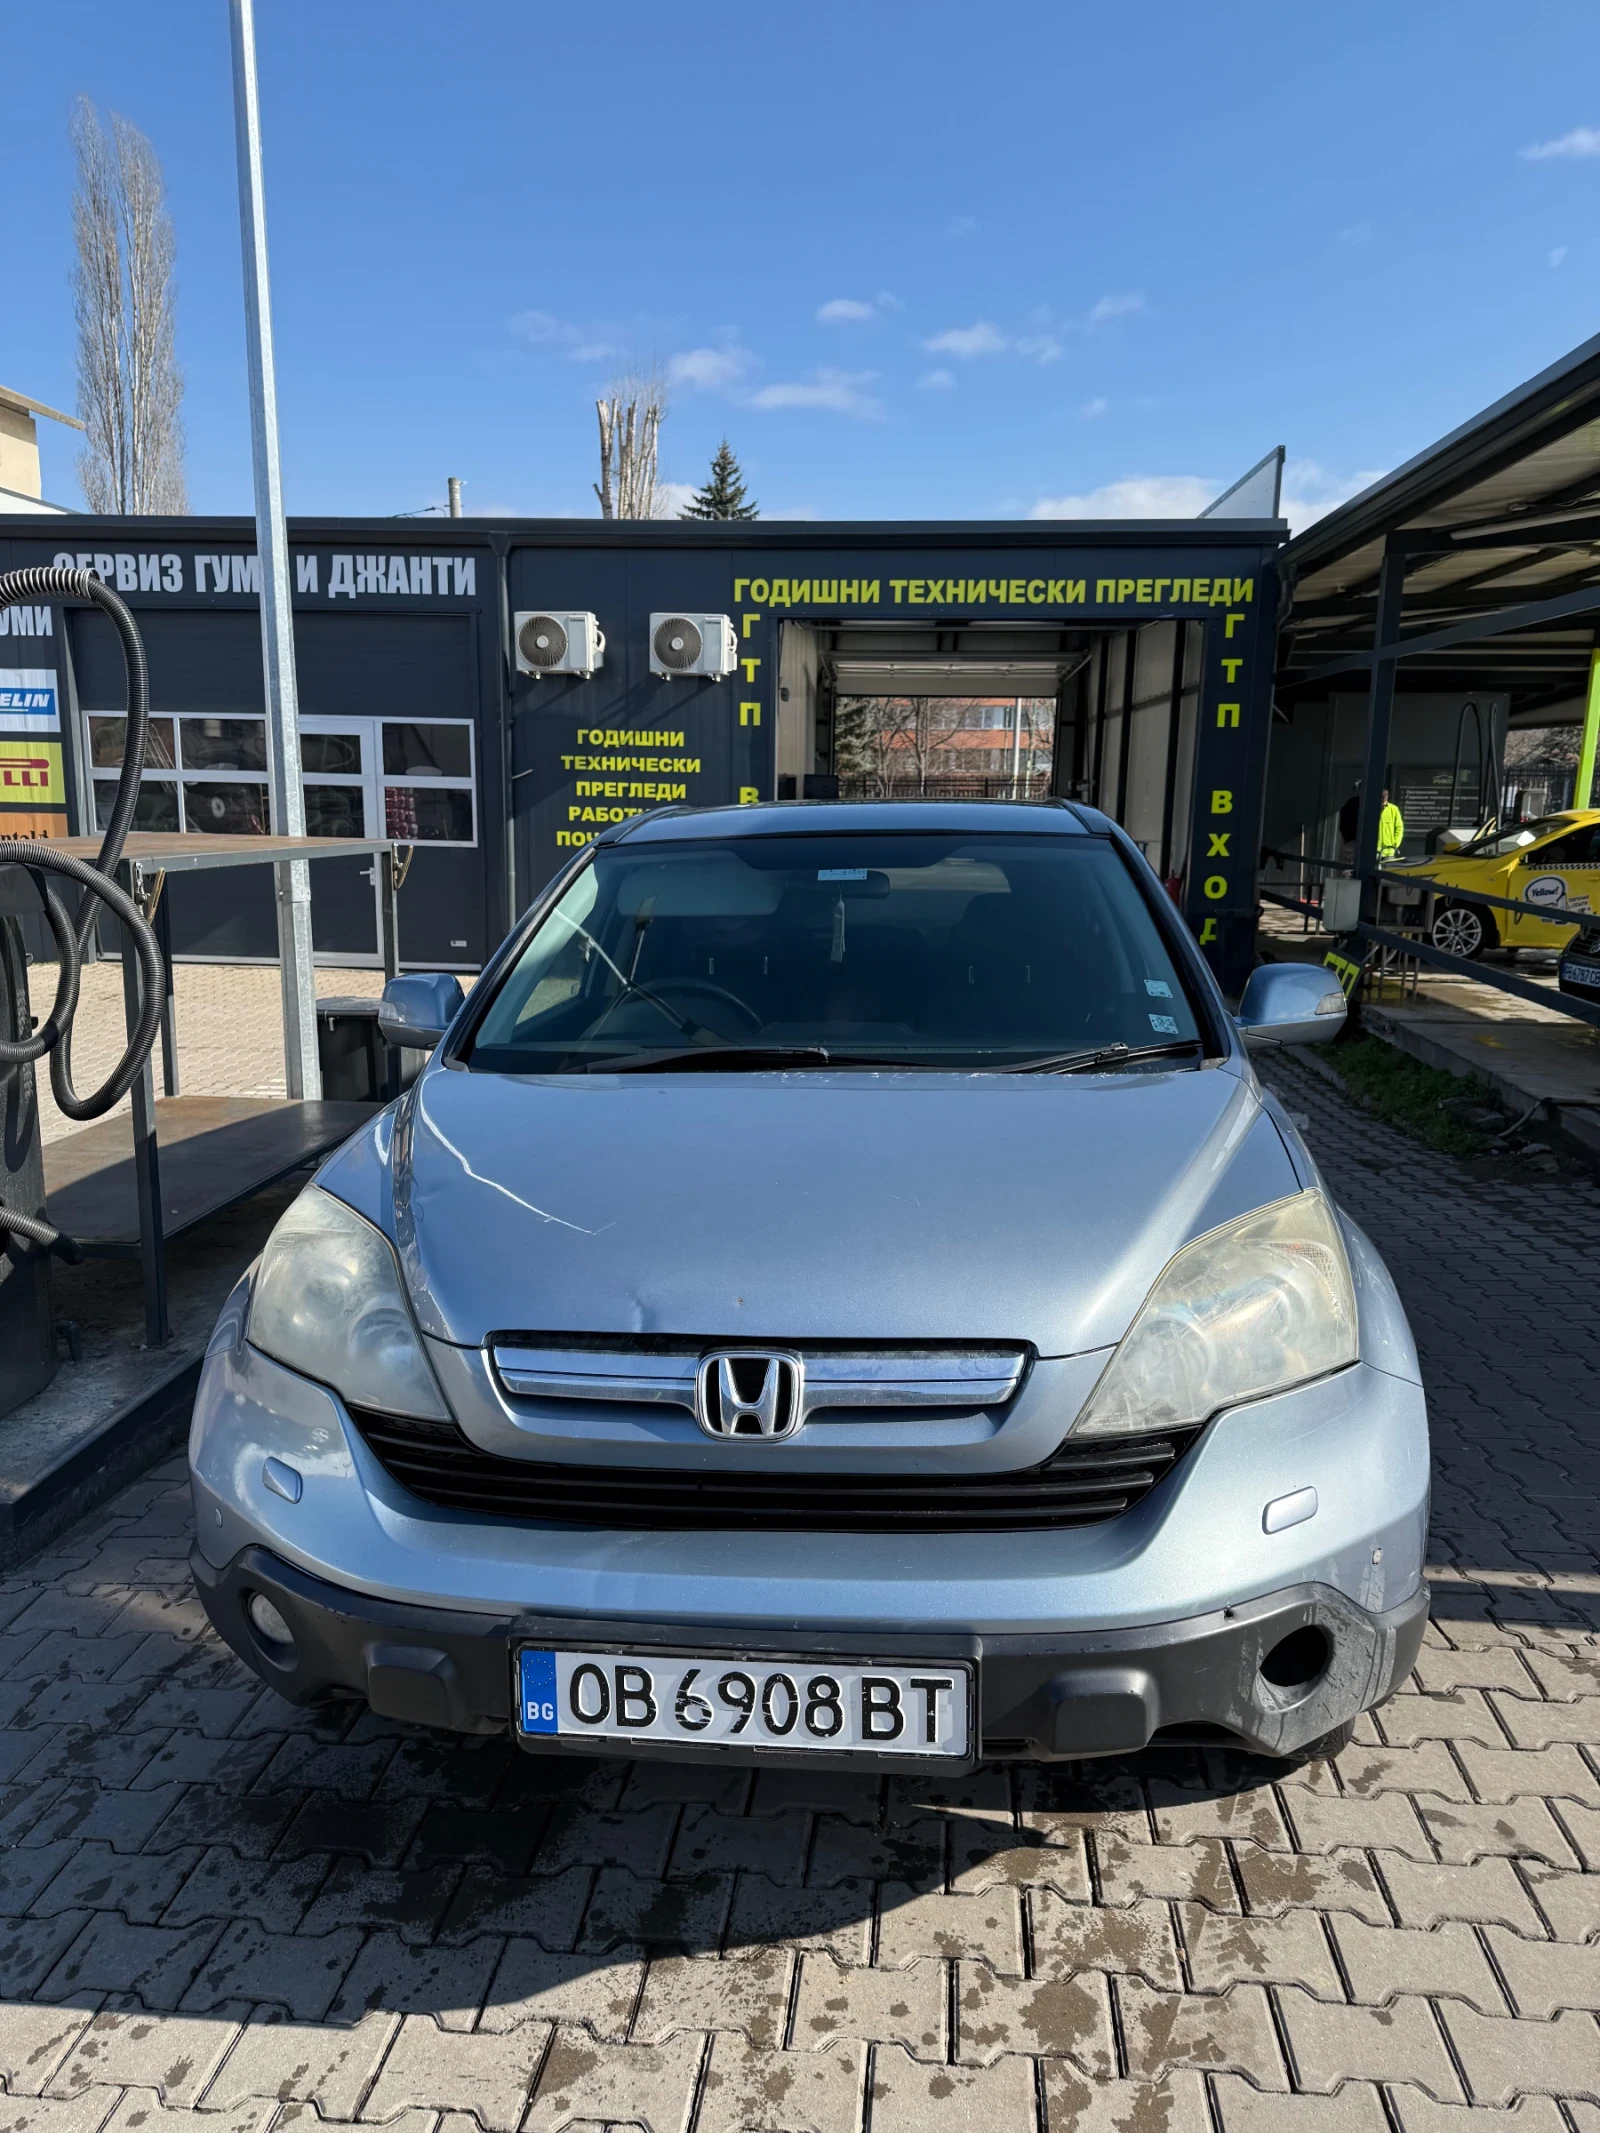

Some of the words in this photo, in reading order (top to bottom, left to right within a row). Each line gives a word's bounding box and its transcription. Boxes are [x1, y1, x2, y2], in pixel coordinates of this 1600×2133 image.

[194, 555, 262, 593] ГУМ
[296, 555, 319, 593] И
[328, 555, 477, 599] ДЖАНТИ
[734, 578, 880, 608] ГОДИШНИ
[889, 579, 1086, 604] ТЕХНИЧЕСКИ
[1096, 578, 1254, 607] ПРЕГЛЕДИ
[577, 729, 685, 749] ГОДИШНИ
[560, 755, 702, 774] ТЕХНИЧЕСКИ
[575, 780, 687, 801] ПРЕГЛЕДИ
[526, 1701, 555, 1721] BG
[569, 1662, 657, 1728] OB
[674, 1668, 844, 1737] 6908
[860, 1676, 954, 1744] BT
